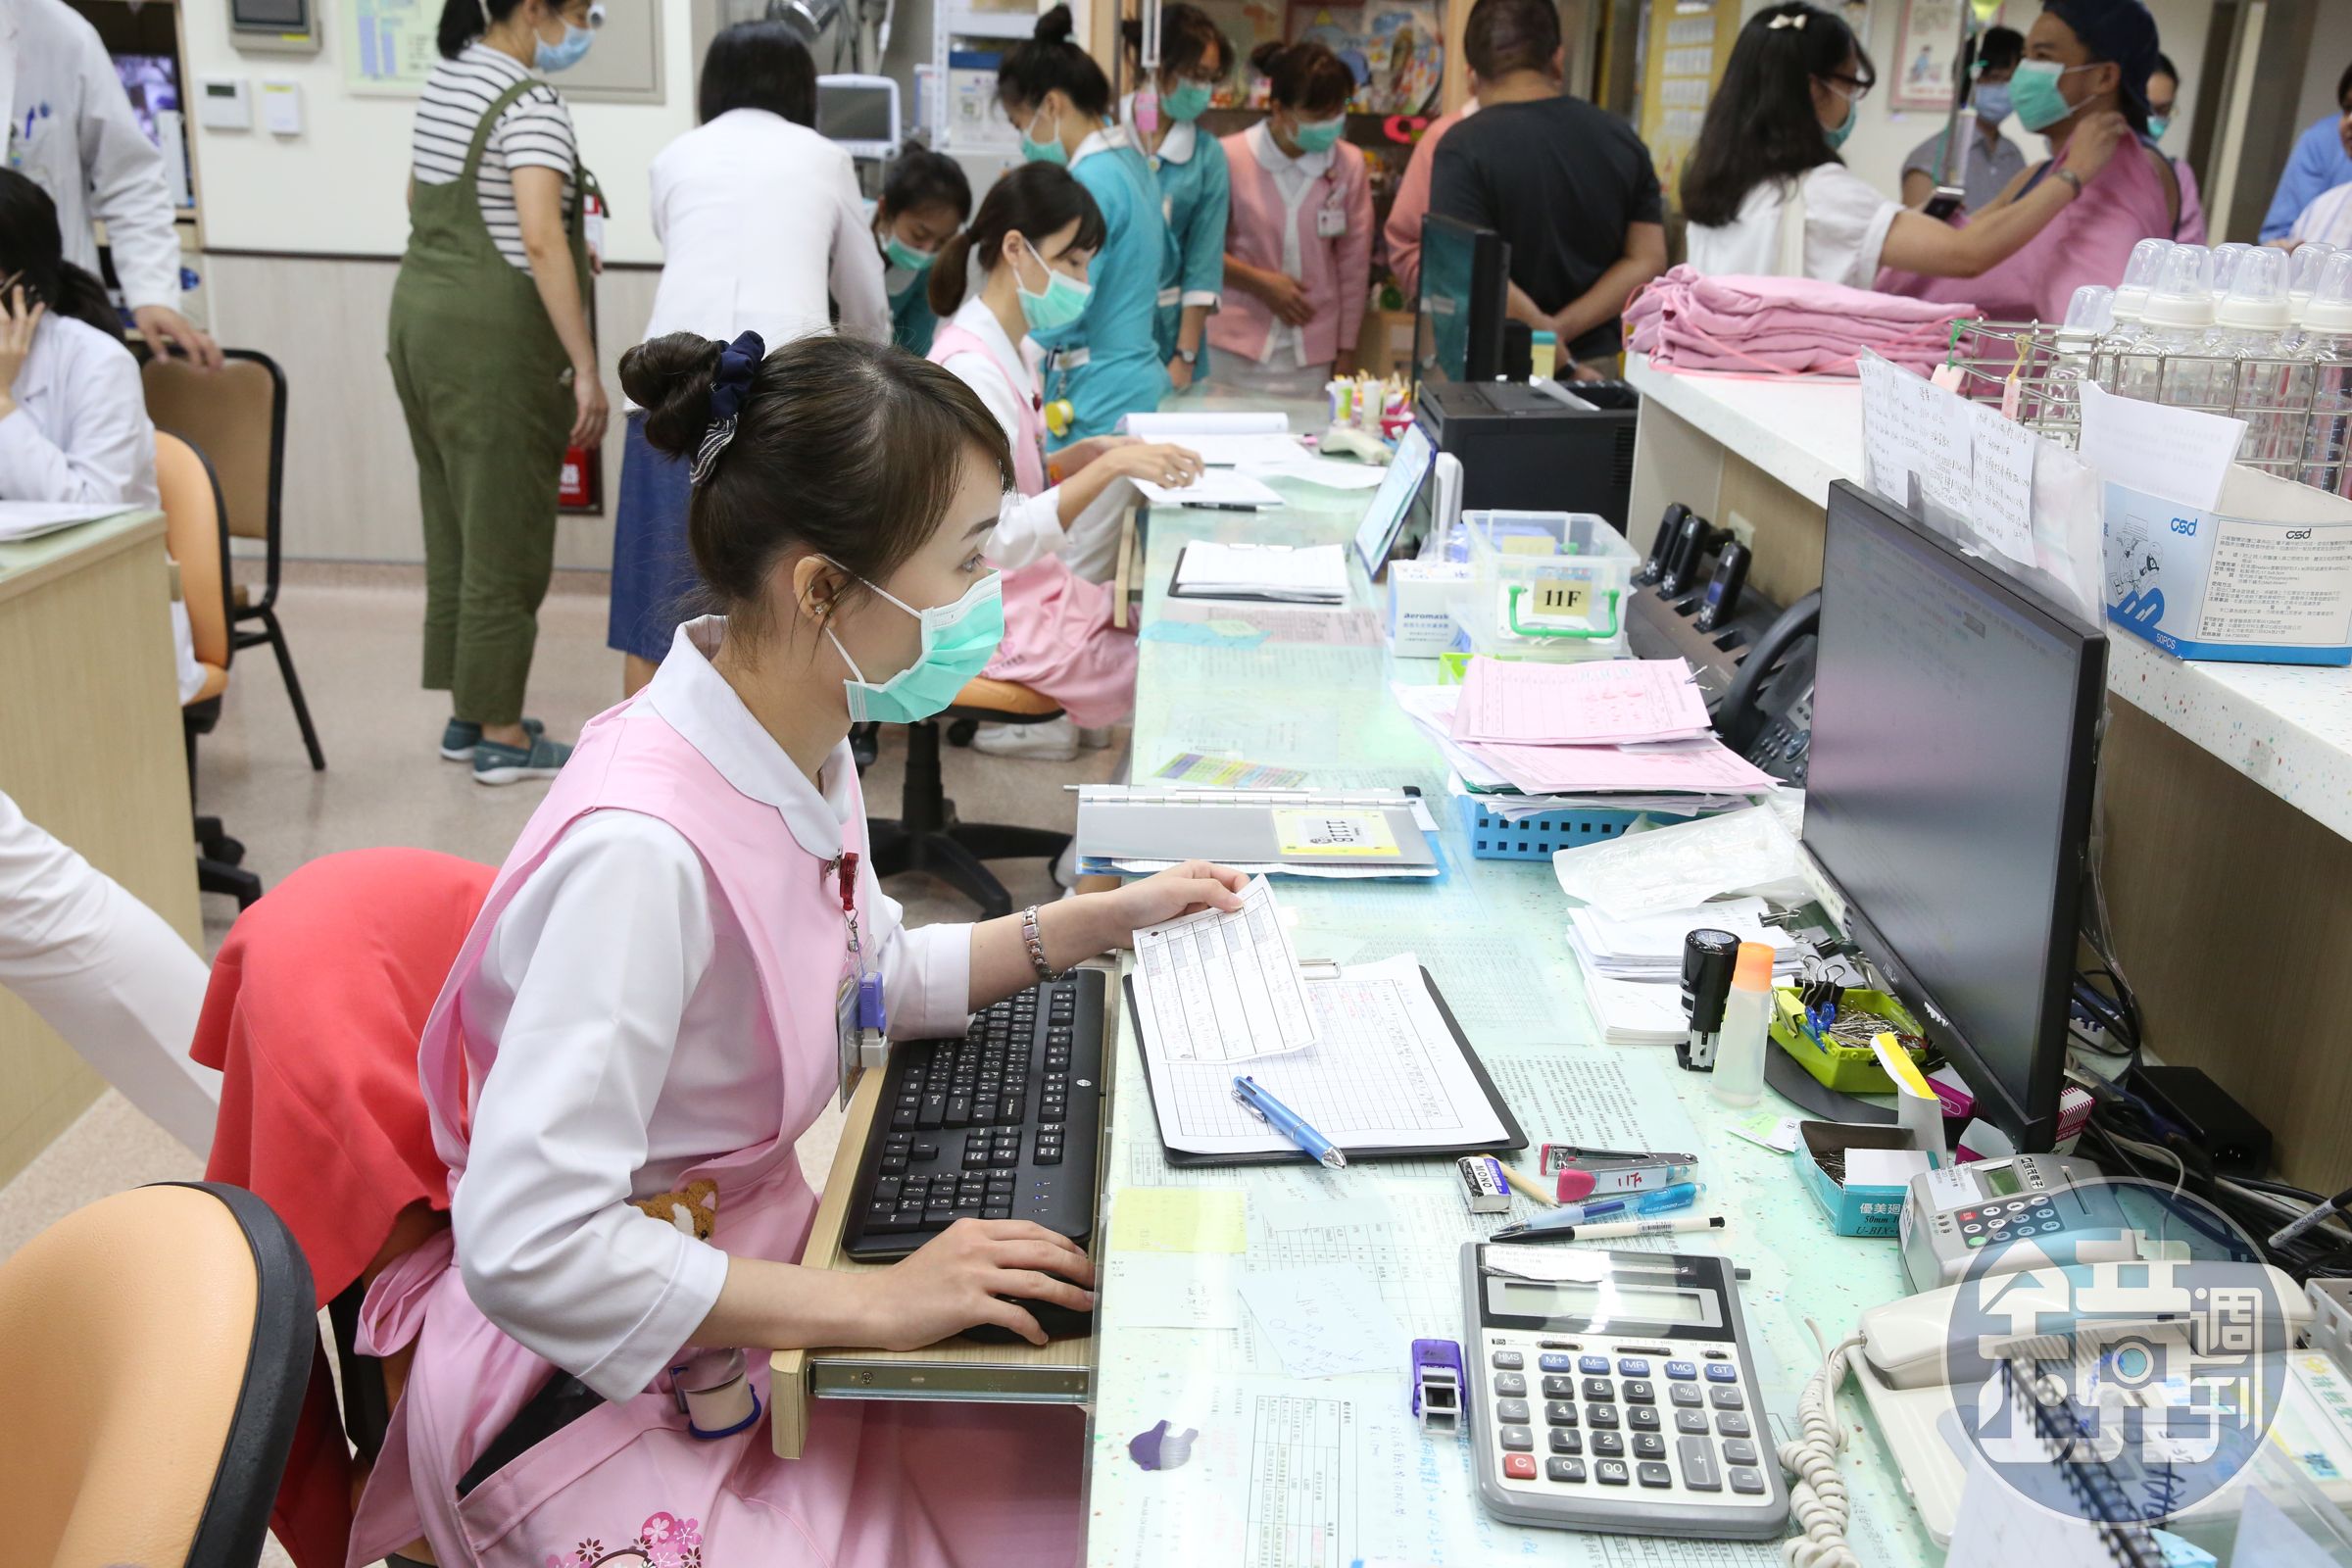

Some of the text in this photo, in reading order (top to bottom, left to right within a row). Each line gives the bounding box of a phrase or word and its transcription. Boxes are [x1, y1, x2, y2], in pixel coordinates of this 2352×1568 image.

[2171, 518, 2198, 536] csd
[2286, 528, 2311, 539] csd
[1545, 590, 1581, 607] 11F
[2156, 633, 2176, 650] 50PCS
[1475, 1165, 1493, 1188] MONO
[1865, 1215, 1892, 1224] 50mm
[1856, 1225, 1900, 1235] U-BIX-
[1498, 1352, 1520, 1361] HMS
[1545, 1356, 1565, 1365] M+
[1625, 1360, 1645, 1369] MR
[1672, 1363, 1692, 1372] MC
[1713, 1365, 1729, 1373] GT
[1502, 1377, 1520, 1386] AC
[1554, 1380, 1562, 1388] 7
[1594, 1382, 1604, 1392] 8
[1634, 1384, 1644, 1393] 9
[1599, 1408, 1608, 1417] 5
[1640, 1410, 1650, 1419] 6
[1563, 1433, 1569, 1442] 1
[1603, 1435, 1613, 1444] 2
[1645, 1438, 1655, 1447] 3
[1515, 1458, 1528, 1468] C
[1563, 1461, 1573, 1470] 0
[1603, 1463, 1623, 1473] 00
